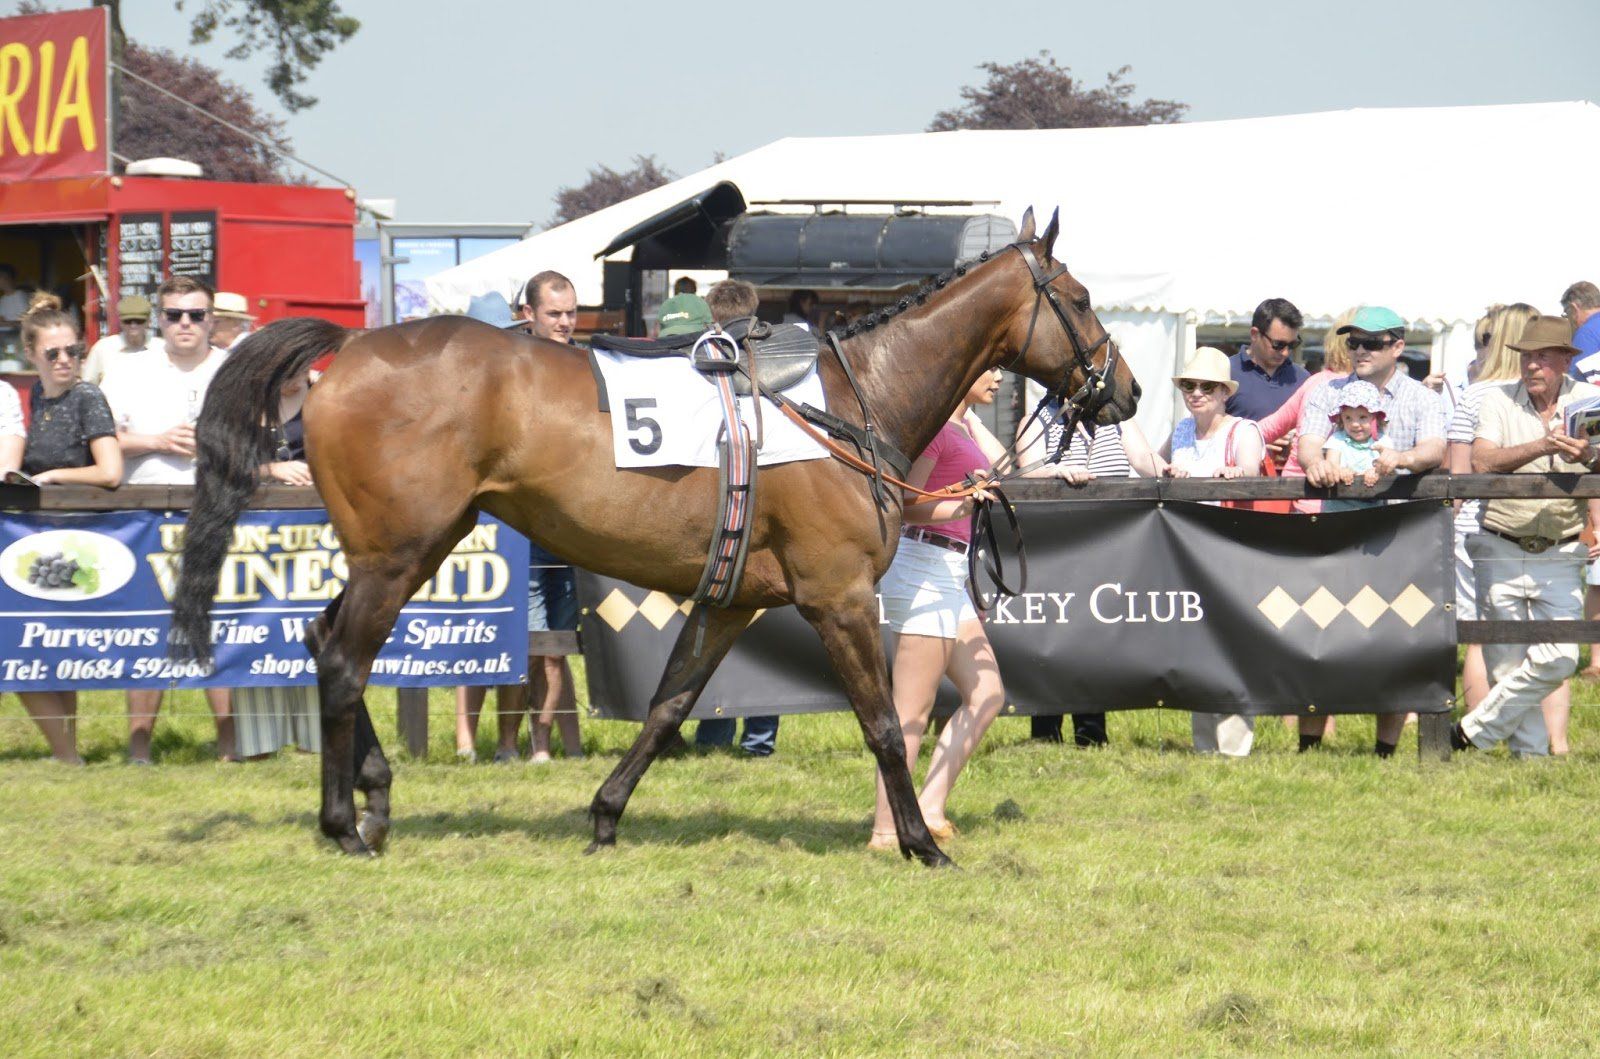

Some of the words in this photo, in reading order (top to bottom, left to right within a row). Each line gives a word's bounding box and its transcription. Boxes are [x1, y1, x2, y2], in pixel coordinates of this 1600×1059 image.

[0, 36, 96, 156] RIA
[624, 398, 662, 455] 5
[1089, 583, 1204, 624] CLUB
[19, 622, 160, 652] Purveyors
[210, 619, 270, 645] Fine
[404, 618, 498, 650] Spirits
[2, 660, 49, 681] Tel:
[56, 657, 125, 680] 01684
